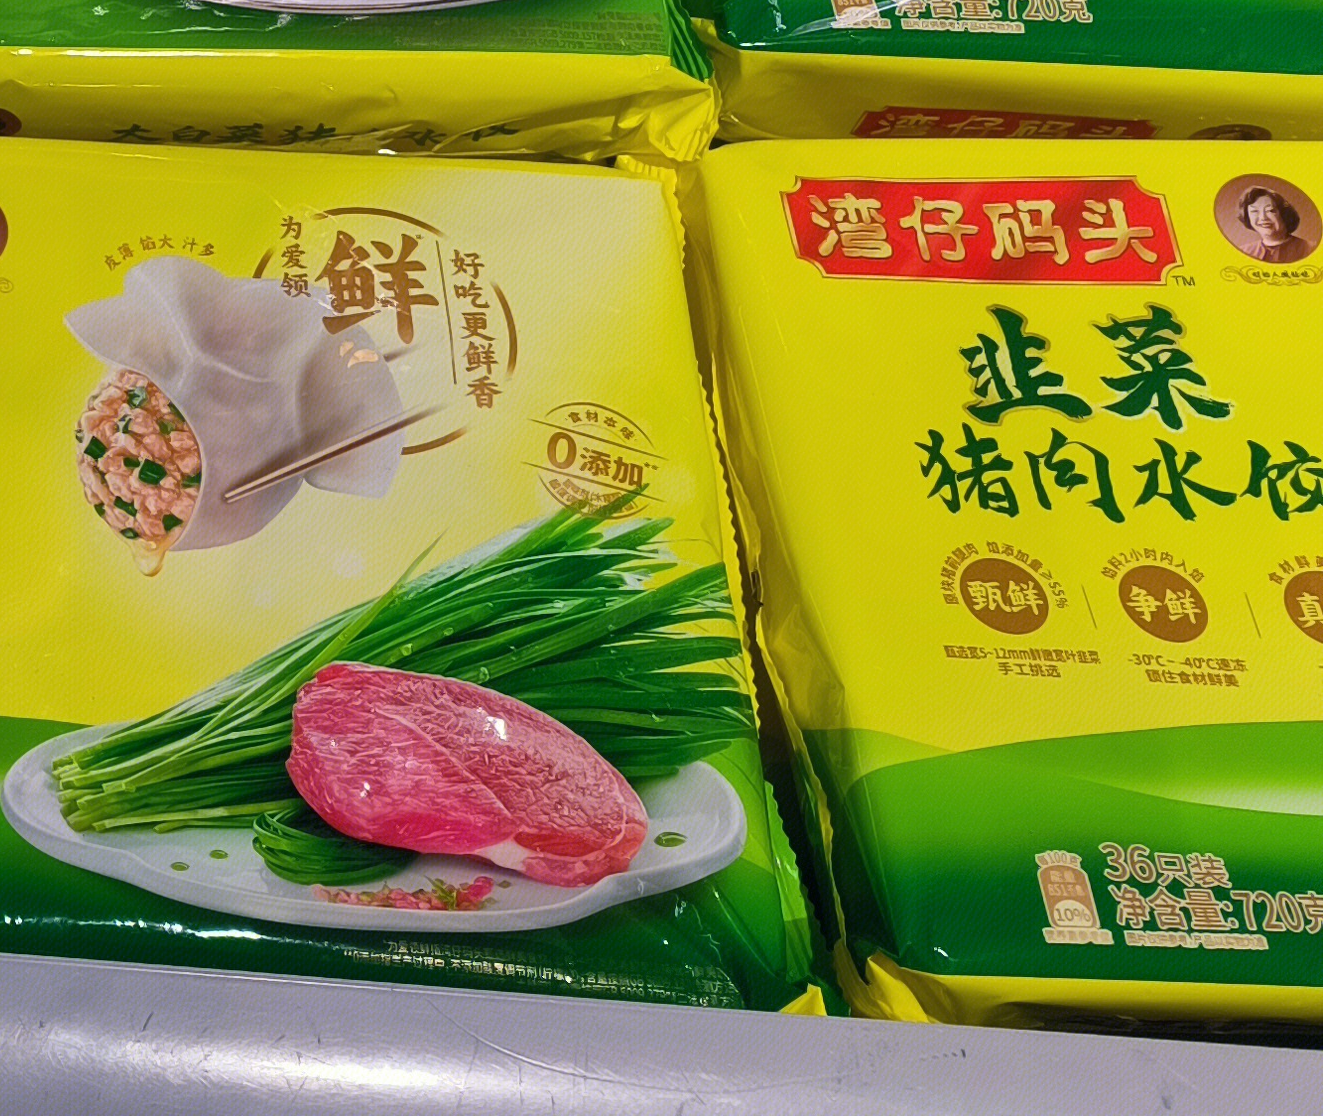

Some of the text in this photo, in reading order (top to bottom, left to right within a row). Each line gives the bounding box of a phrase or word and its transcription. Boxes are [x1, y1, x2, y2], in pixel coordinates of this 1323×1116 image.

[103, 234, 218, 272] 皮薄馅大汁多
[809, 192, 1197, 287] 湾仔码头 TM
[280, 214, 504, 410] 为爱领 鲜 好吃更鲜香
[957, 303, 1235, 432] 韭菜
[546, 431, 644, 488] 0添加
[913, 422, 1323, 524] 猪肉水饺
[966, 579, 1045, 616] 甄鲜
[1126, 583, 1202, 625] 争鲜
[1097, 841, 1233, 889] 36只装
[1054, 906, 1092, 924] 10%
[1107, 883, 1323, 935] 净含量:720克
